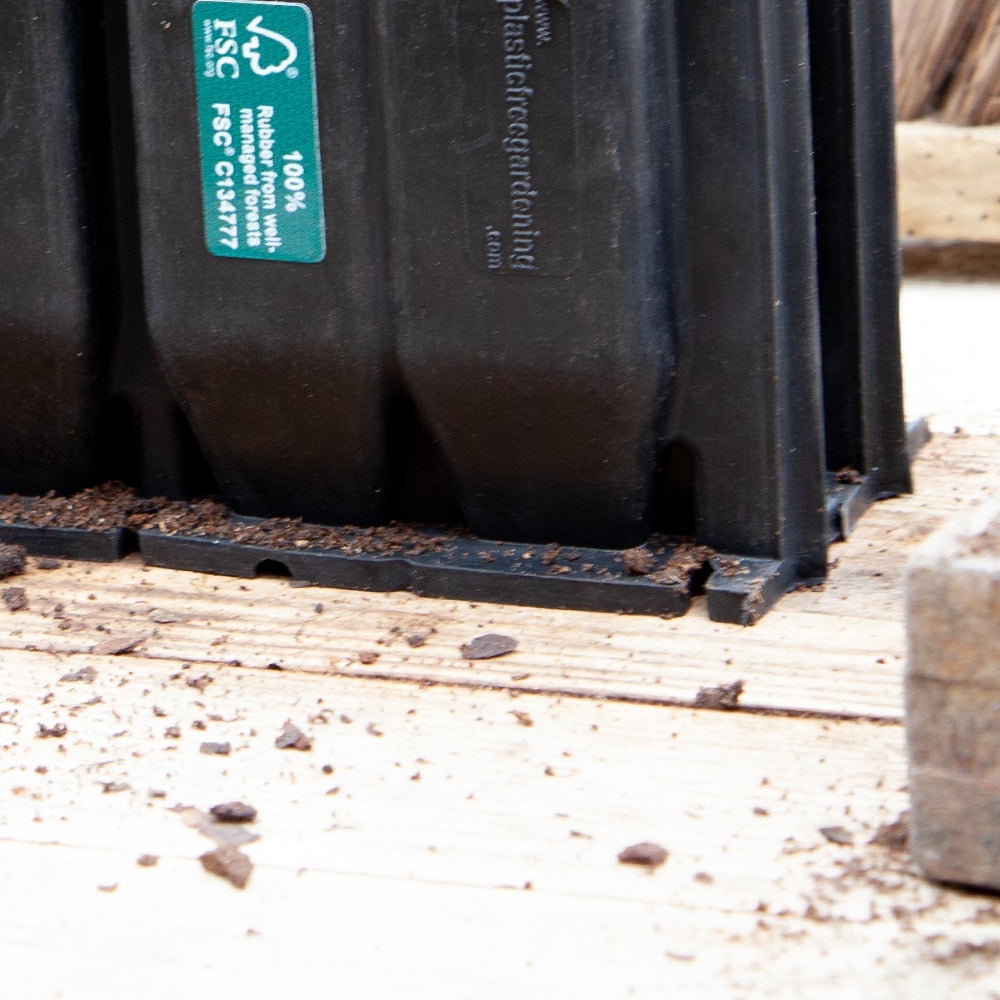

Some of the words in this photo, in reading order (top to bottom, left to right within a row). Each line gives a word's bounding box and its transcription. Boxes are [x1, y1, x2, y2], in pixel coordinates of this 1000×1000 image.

[213, 18, 240, 79] FSC
[238, 107, 260, 186] managed
[256, 104, 276, 168] Rubber
[214, 161, 239, 250] C134777
[260, 170, 279, 210] from
[282, 150, 306, 213] 100%
[244, 189, 263, 247] forests
[263, 213, 282, 254] well-
[485, 225, 503, 269] .com
